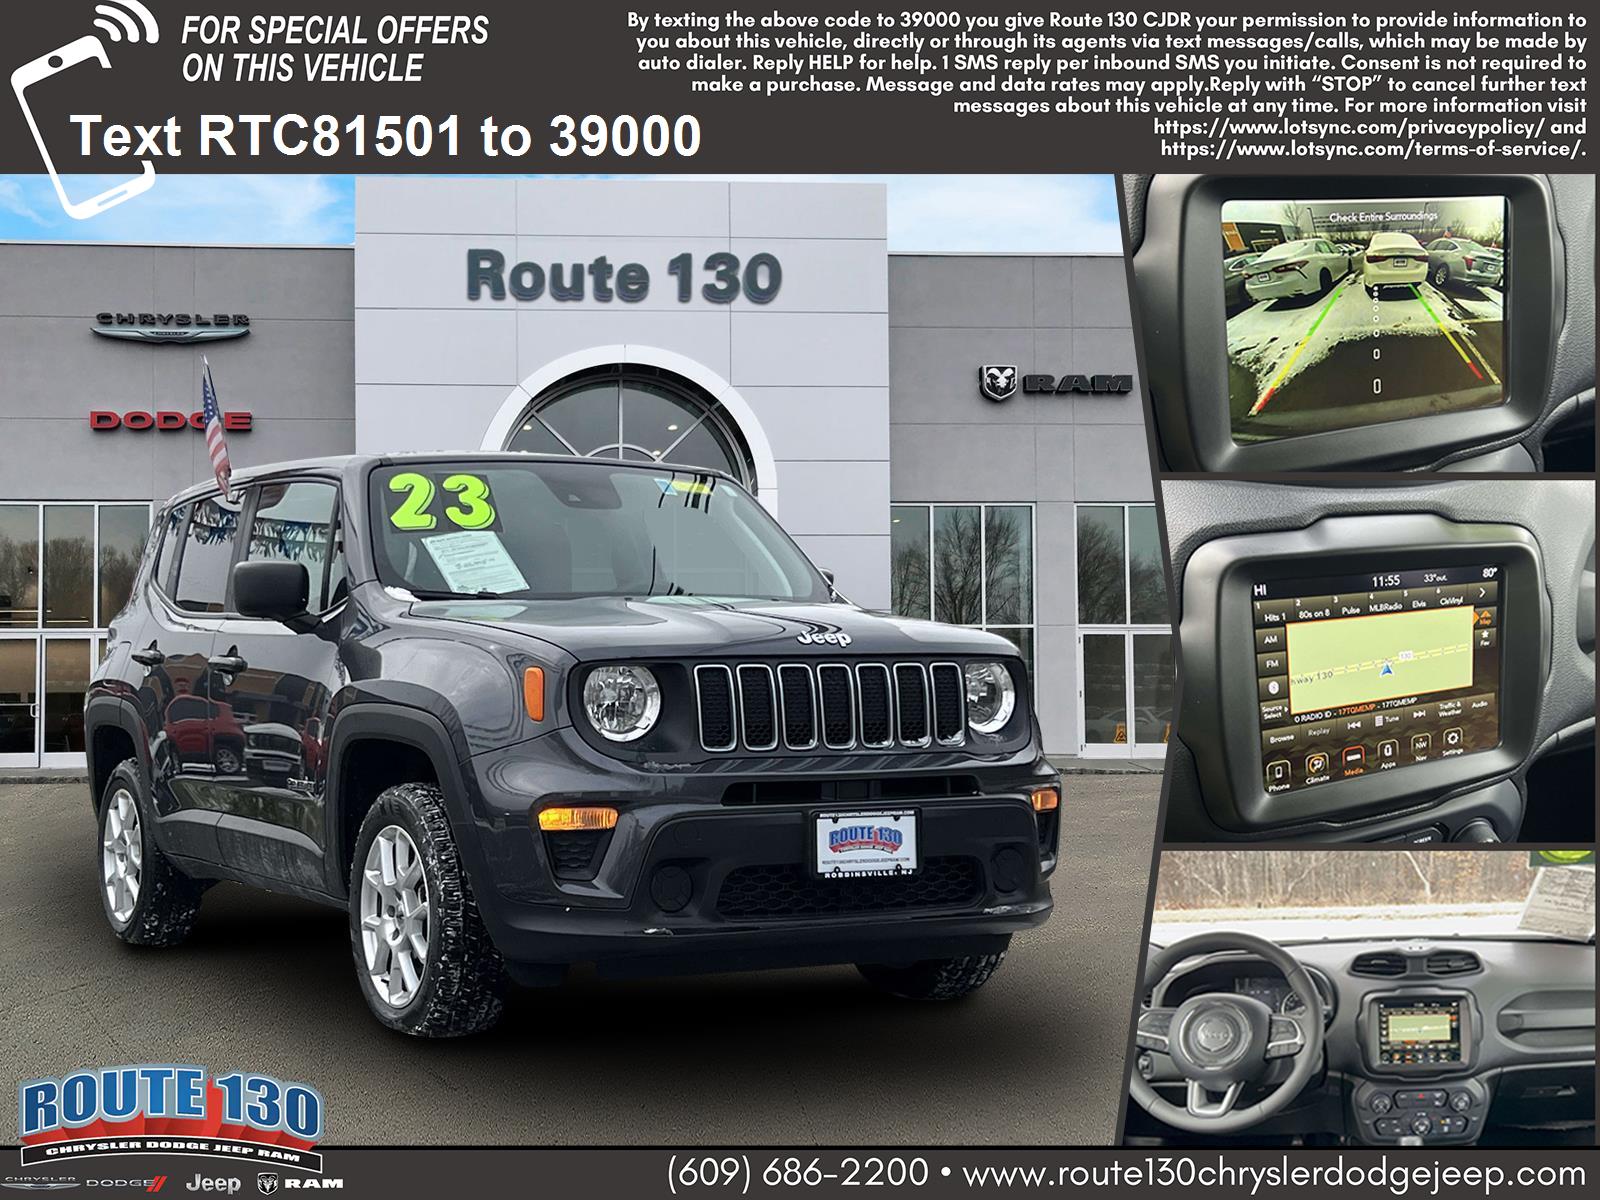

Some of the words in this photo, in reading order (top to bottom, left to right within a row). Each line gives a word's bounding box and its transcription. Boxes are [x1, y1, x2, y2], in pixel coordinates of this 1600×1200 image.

[1329, 212, 1357, 222] Check
[1359, 211, 1383, 221] Entire
[1385, 211, 1438, 221] Surroundings
[467, 248, 650, 303] Route
[668, 251, 783, 304] 130
[96, 312, 250, 326] CHRYSLER
[1023, 374, 1133, 394] RAM
[389, 472, 496, 531] 23
[1372, 574, 1401, 587] 11:55
[1254, 585, 1267, 596] HI
[797, 631, 852, 648] Jeep
[1264, 635, 1278, 644] AM
[1266, 659, 1279, 668] FM
[1270, 734, 1295, 744] Browse
[1308, 729, 1330, 738] Replay
[1305, 775, 1330, 784] Climate
[1268, 783, 1290, 792] Phone
[829, 825, 875, 846] ROUTE
[876, 826, 903, 846] 130
